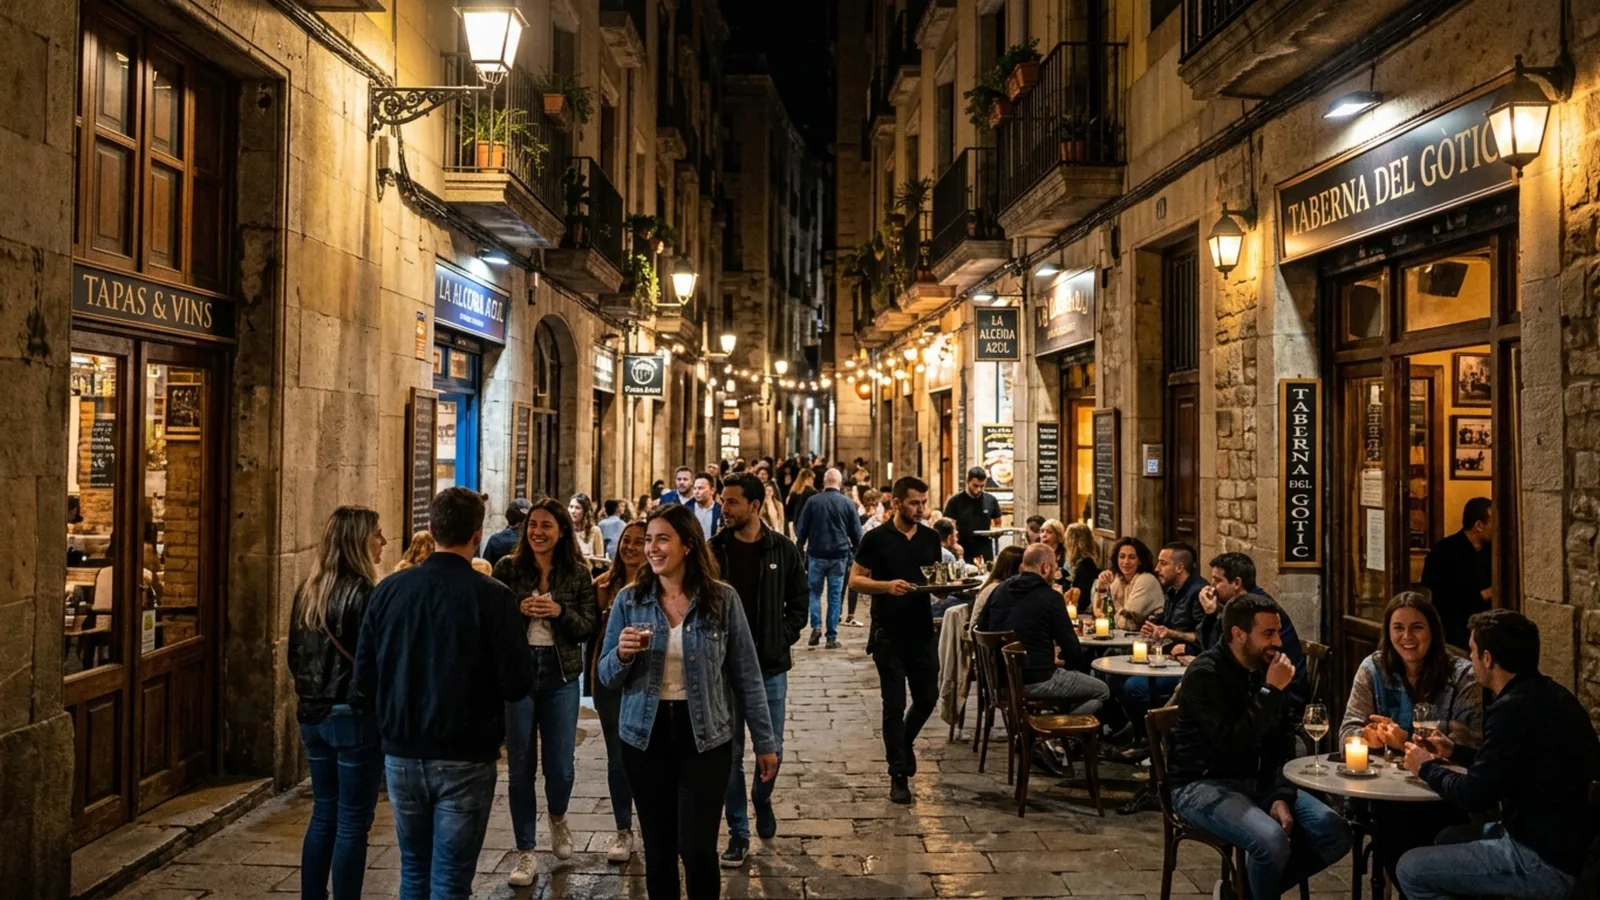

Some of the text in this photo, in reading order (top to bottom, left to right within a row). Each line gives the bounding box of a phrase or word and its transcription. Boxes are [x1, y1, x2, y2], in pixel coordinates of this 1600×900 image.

[1288, 174, 1371, 237] TABERNA
[1373, 155, 1415, 207] DEL
[83, 274, 213, 328] TAPAS & VINS
[439, 275, 451, 303] LA
[991, 314, 1004, 326] LA
[1291, 388, 1310, 476] TABERNA
[1291, 493, 1310, 558] GOTIC
